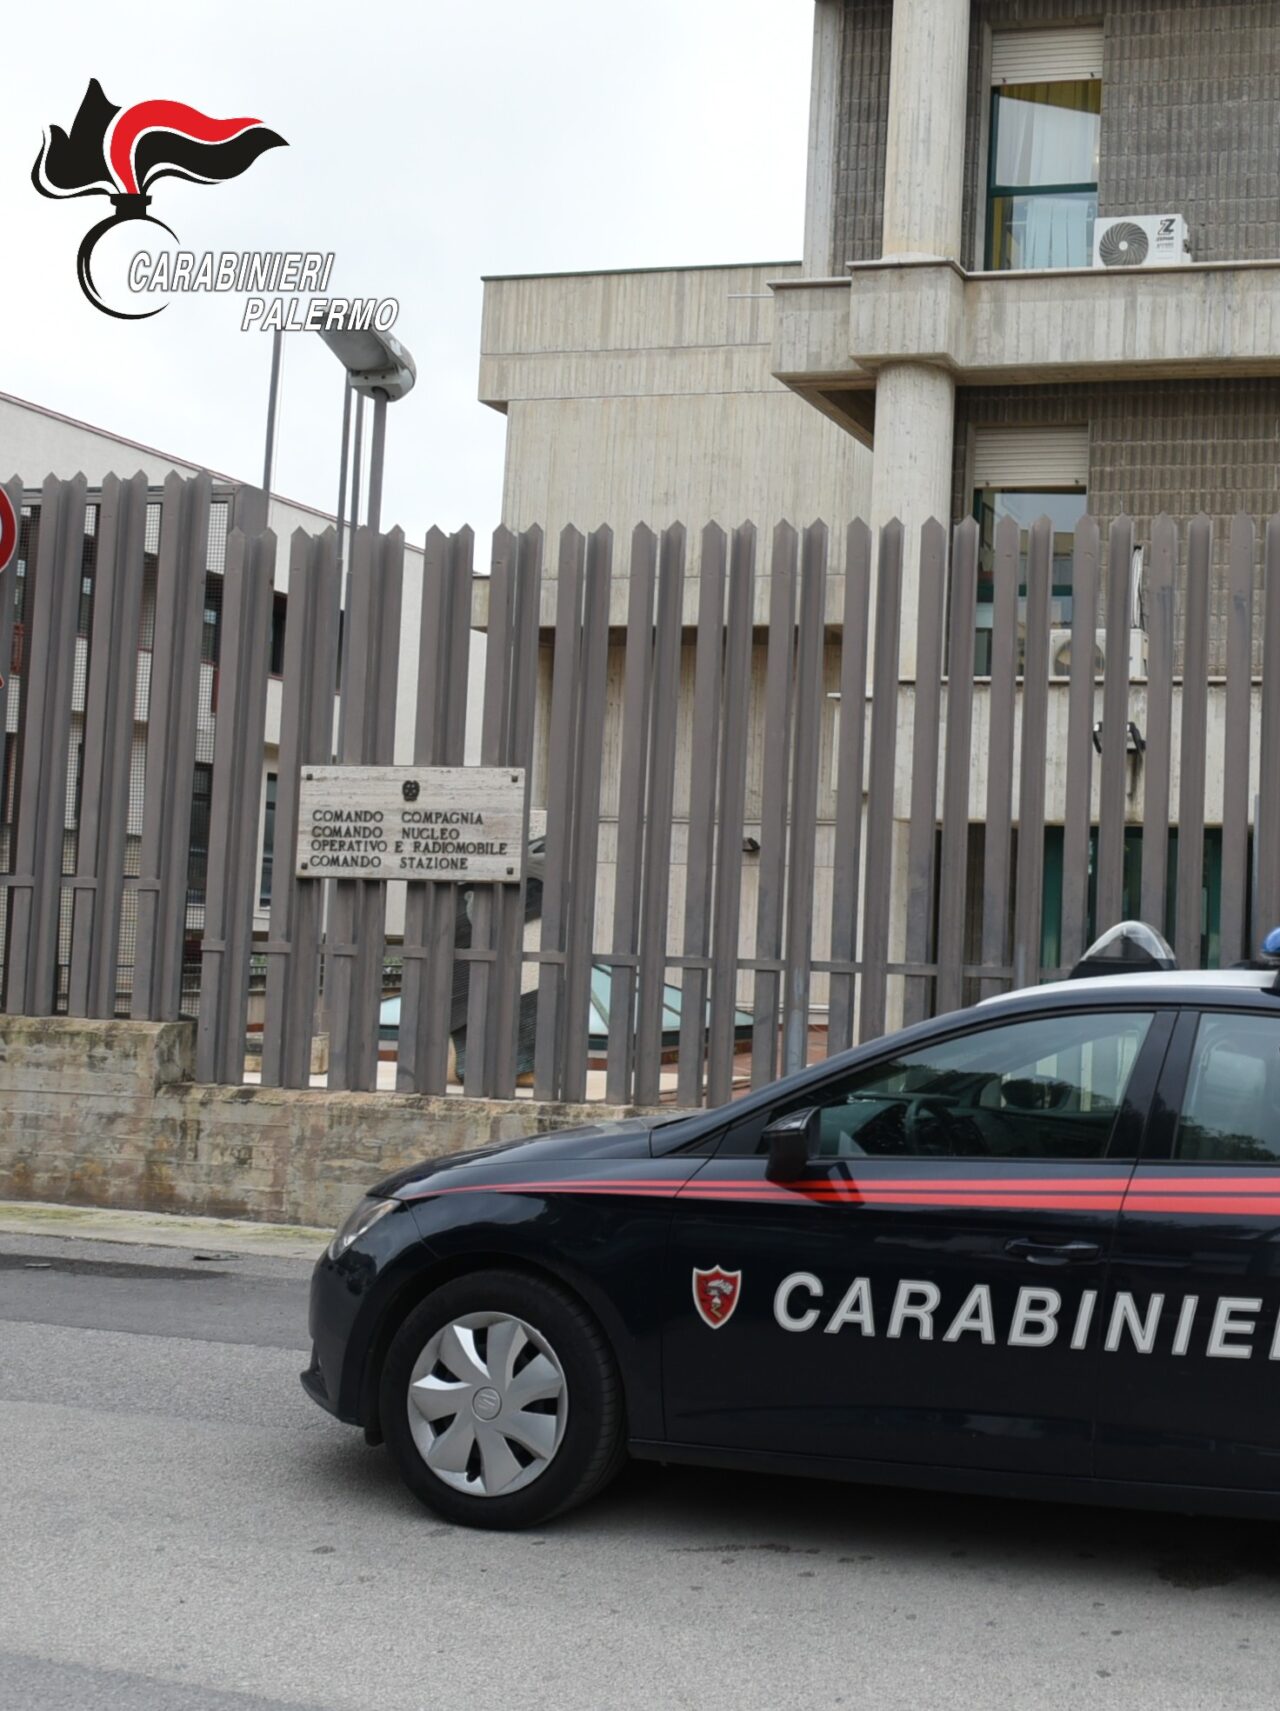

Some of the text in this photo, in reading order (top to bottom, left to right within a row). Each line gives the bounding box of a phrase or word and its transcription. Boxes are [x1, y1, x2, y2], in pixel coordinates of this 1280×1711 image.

[312, 809, 483, 826] COMANDO COMPAGNIA
[311, 825, 460, 841] COMANDO NUCLEO
[310, 839, 508, 856] OPERATIVO E RADIOMOBILE
[309, 855, 468, 871] COMANDO STAZIONE
